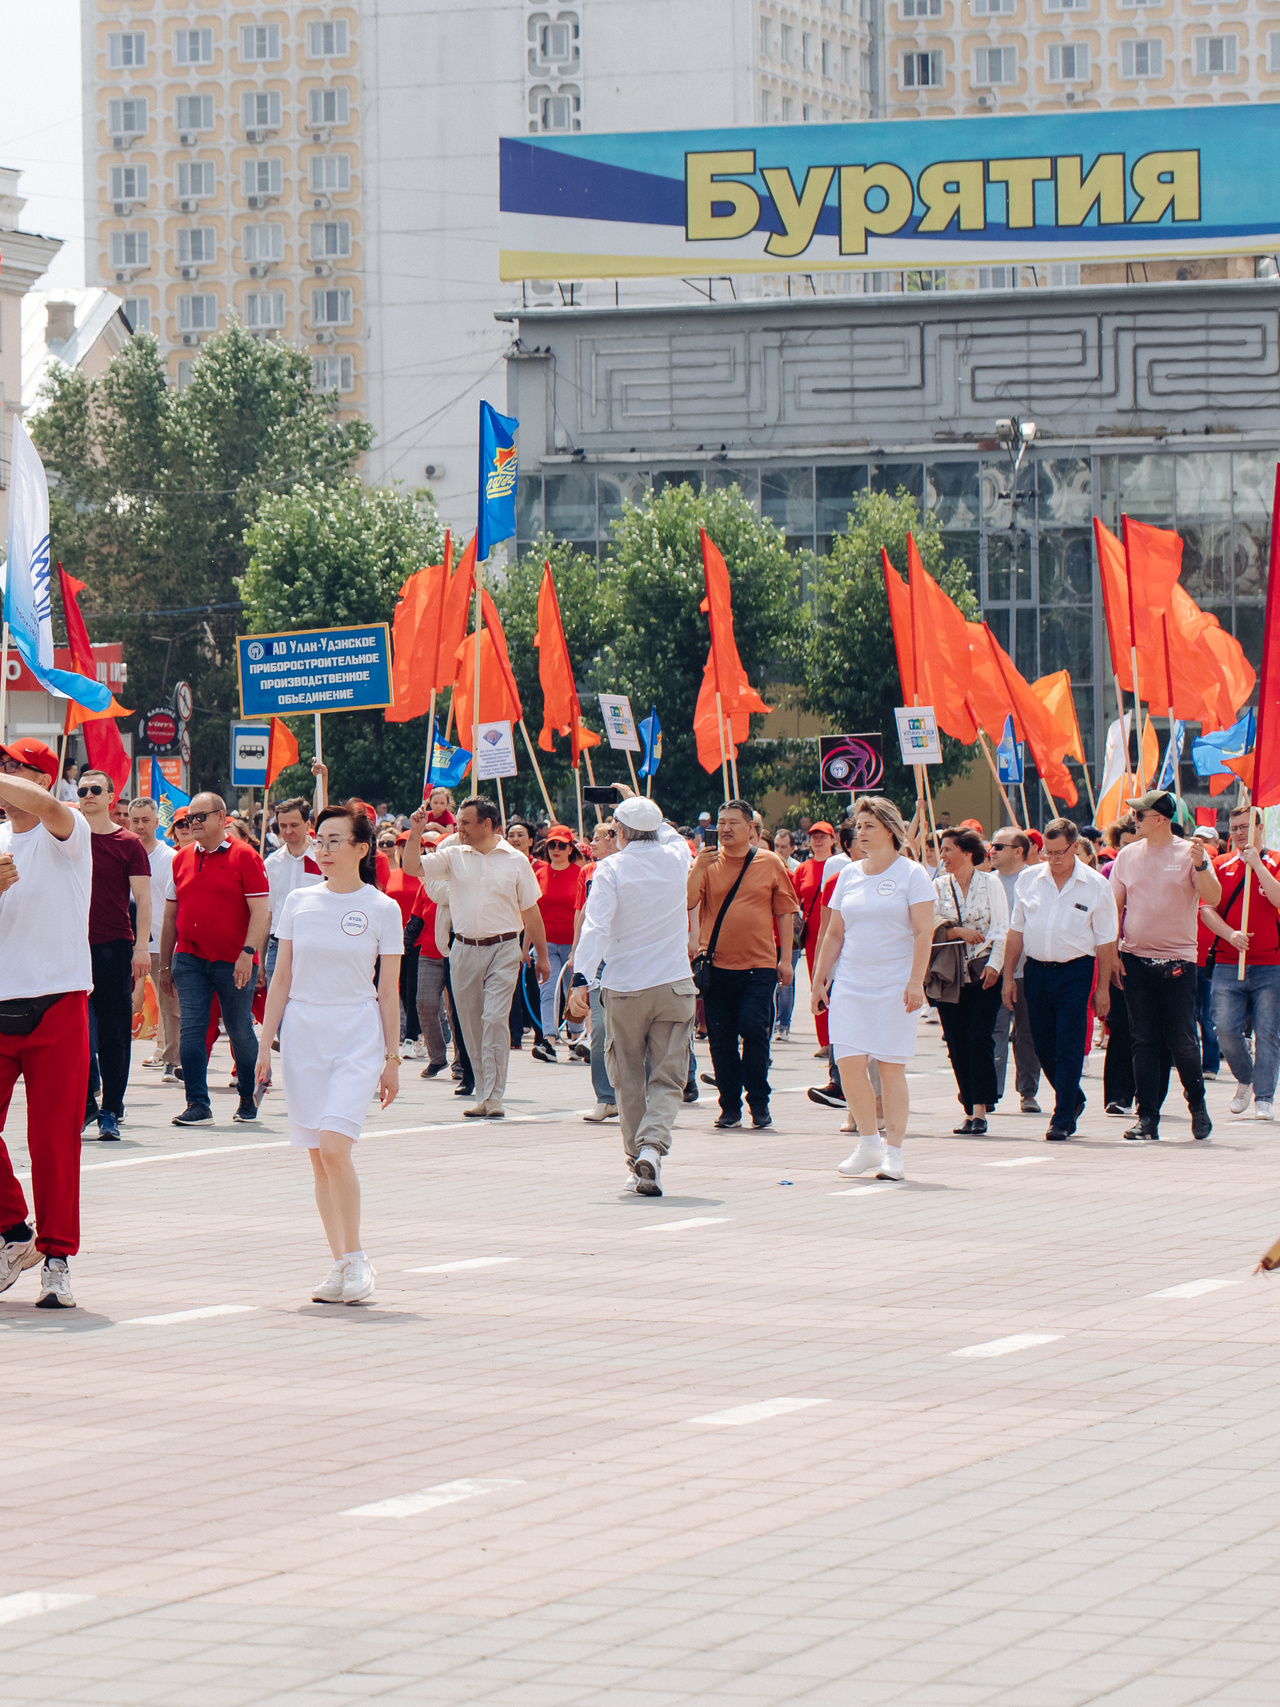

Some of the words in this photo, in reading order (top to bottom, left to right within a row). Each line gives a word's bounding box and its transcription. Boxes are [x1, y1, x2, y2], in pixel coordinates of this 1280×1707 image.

[684, 147, 1202, 257] Бурятия
[273, 641, 287, 656] АО
[249, 653, 380, 674] ПРИБОРОСТРОИТЕЛЬНОЕ
[260, 671, 370, 690] ПРОИЗВОДСТВЕННОЕ
[148, 742, 172, 751] CLUB
